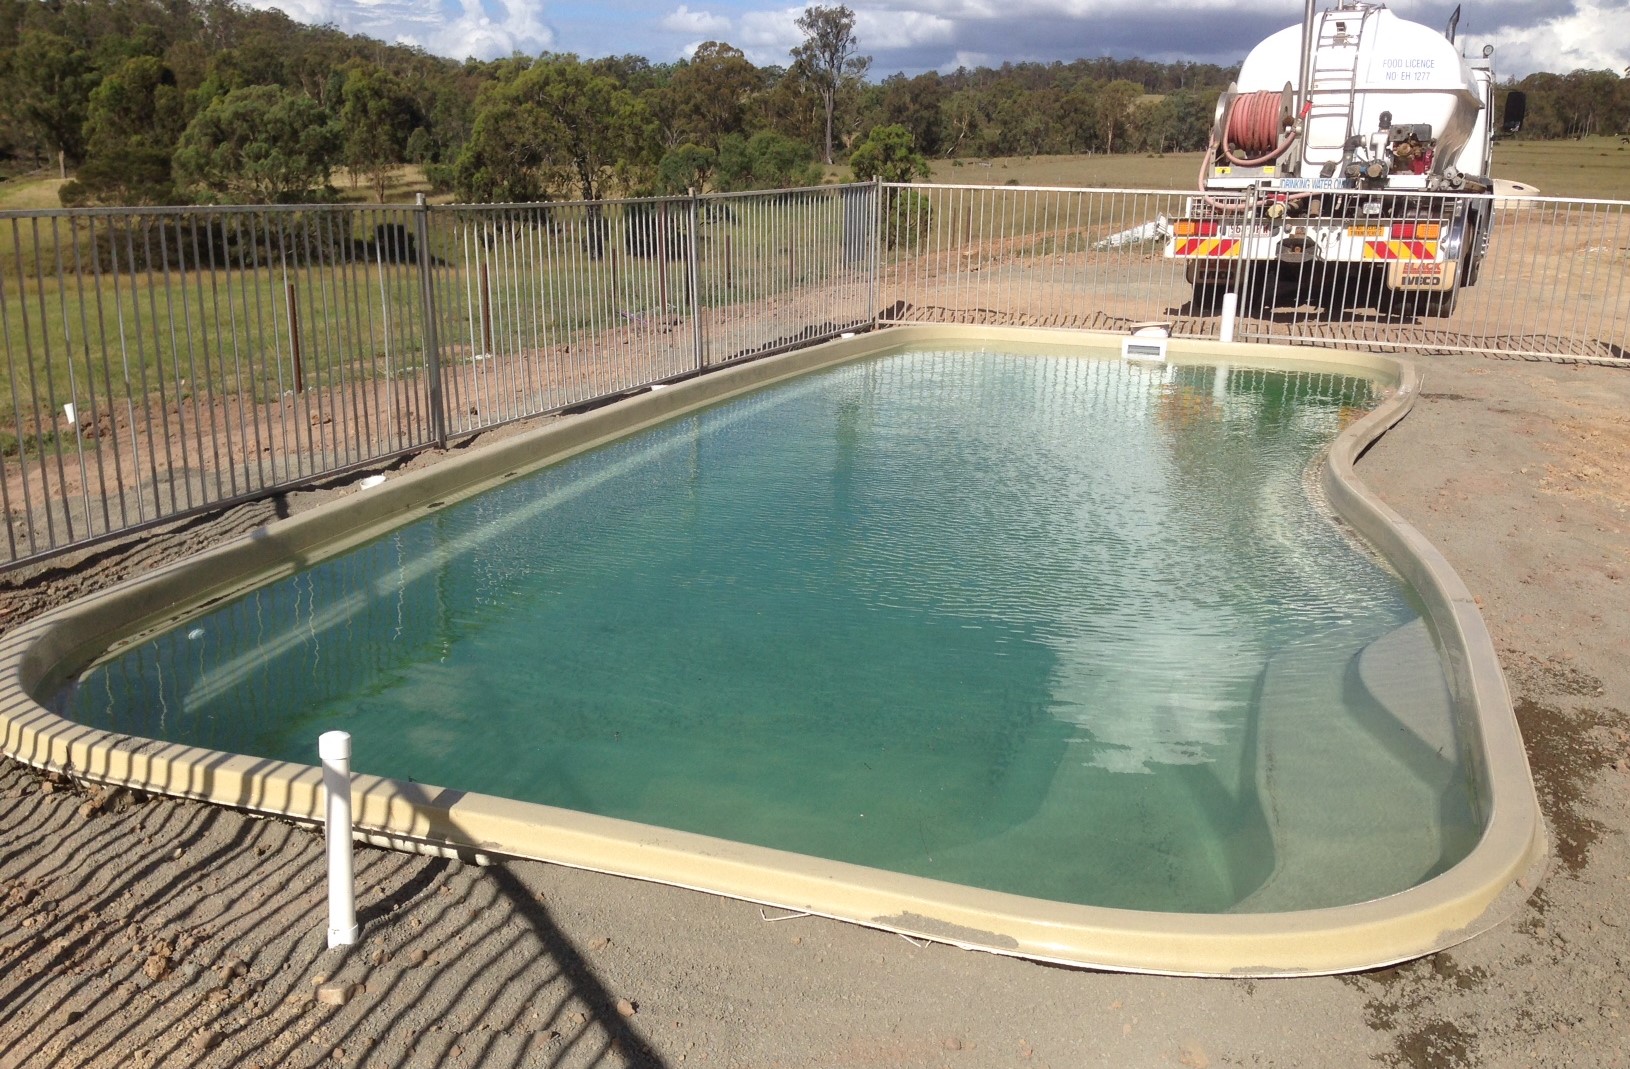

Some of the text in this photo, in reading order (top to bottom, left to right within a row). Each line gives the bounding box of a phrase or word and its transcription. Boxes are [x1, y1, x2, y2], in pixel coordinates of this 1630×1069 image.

[1383, 59, 1435, 68] FOOD LICENCE
[1401, 72, 1411, 80] EH
[1414, 72, 1431, 80] 1277
[1281, 179, 1310, 189] DRINKING
[1312, 179, 1332, 189] WATER
[1403, 262, 1441, 271] BLACK
[1402, 276, 1440, 285] IVECO
